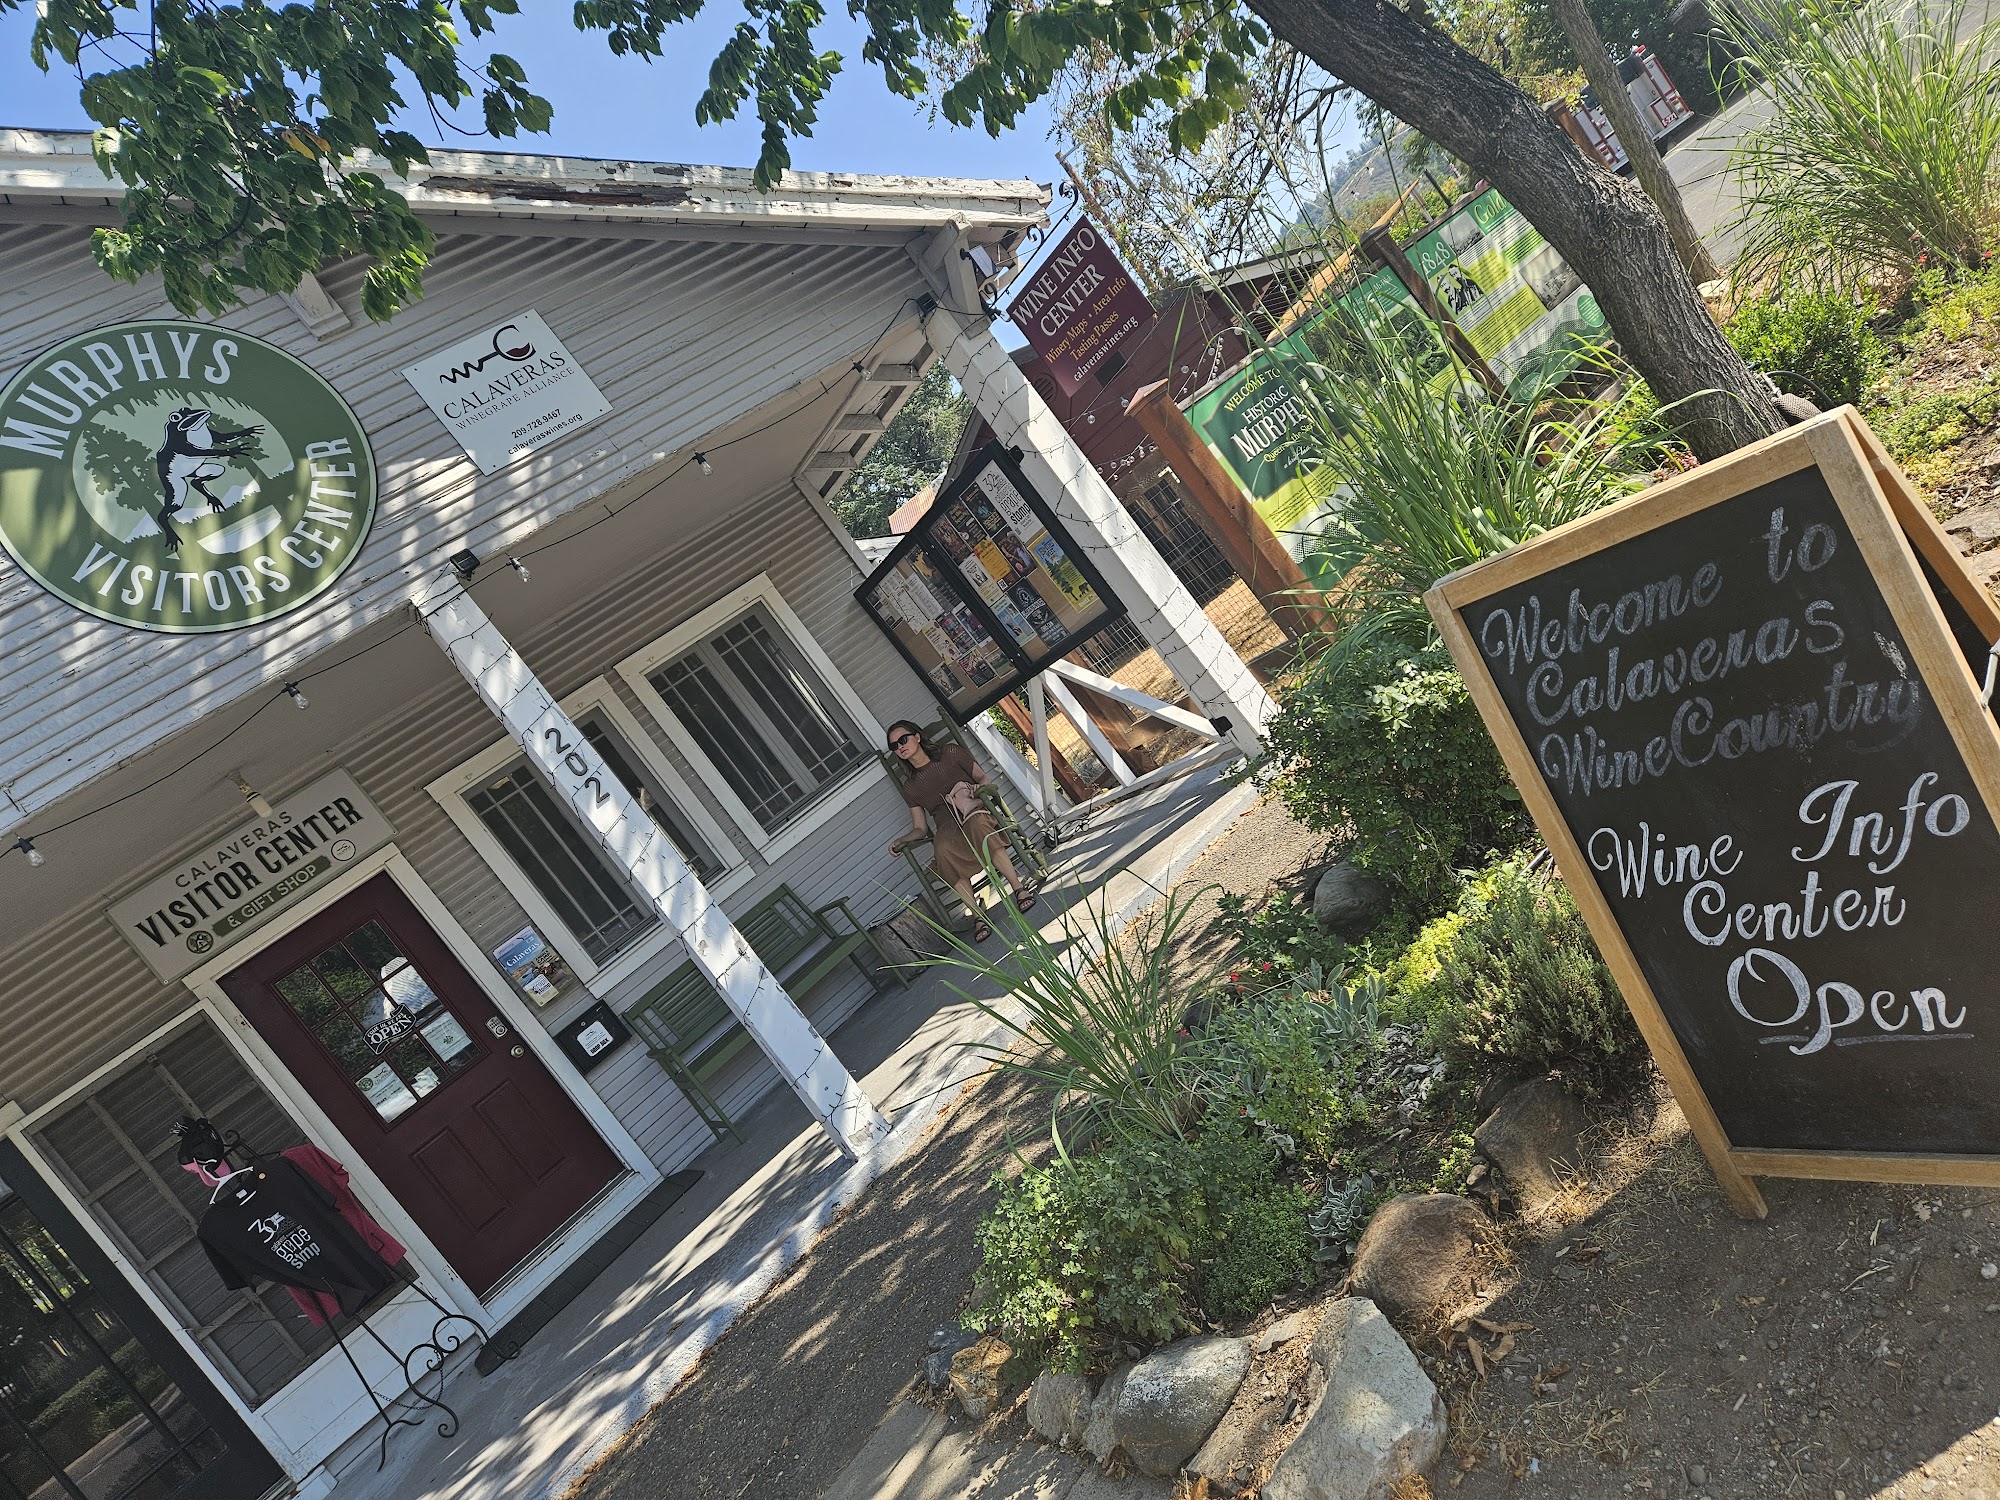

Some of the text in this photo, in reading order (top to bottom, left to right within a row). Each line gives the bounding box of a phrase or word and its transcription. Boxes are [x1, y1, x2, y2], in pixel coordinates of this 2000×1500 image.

[1474, 191, 1508, 225] Gold
[1012, 227, 1096, 326] WINE INFO
[1419, 242, 1451, 275] 1848
[1040, 263, 1106, 337] CENTER
[1045, 276, 1127, 364] Winery Maps Area Info
[1070, 310, 1120, 361] Tasting Passes
[1073, 315, 1139, 382] calaveraswines.org
[0, 331, 239, 460] MURPHYS
[443, 351, 566, 419] CALAVERAS
[455, 366, 575, 431] WINEGRAPE ALLIANCE
[1223, 374, 1267, 412] WELCOME
[1241, 385, 1289, 425] HISTORIC
[507, 413, 583, 455] calaveraswines.org
[511, 408, 562, 439] 209.728.9467
[72, 437, 357, 613] VISITORS CENTER
[1010, 502, 1032, 525] stomp
[1482, 506, 1838, 675] Welcome to
[544, 727, 611, 804] 202
[175, 811, 293, 888] CALAVERAS
[1587, 771, 1970, 899] Wine Info
[134, 797, 364, 948] VISITOR CENTER
[226, 864, 317, 928] & GIFT SHOP
[1683, 871, 1905, 946] Center
[506, 942, 540, 967] Calaveras
[370, 1013, 412, 1044] OPEN
[1726, 947, 1966, 1055] Open
